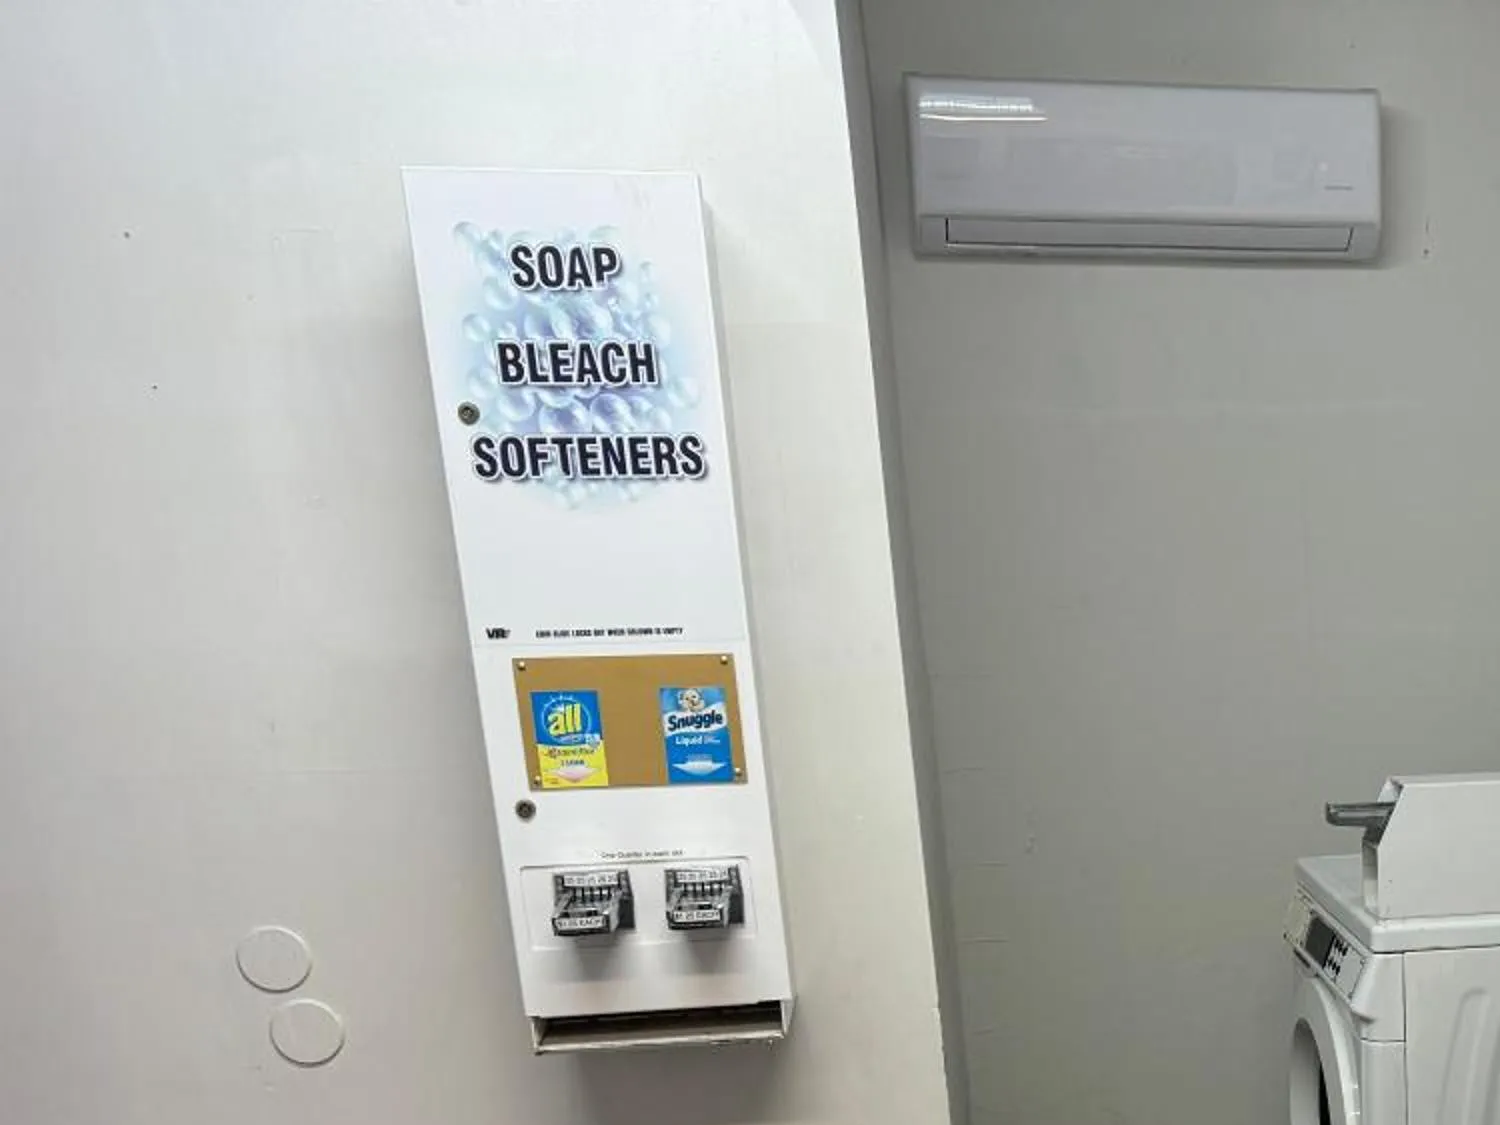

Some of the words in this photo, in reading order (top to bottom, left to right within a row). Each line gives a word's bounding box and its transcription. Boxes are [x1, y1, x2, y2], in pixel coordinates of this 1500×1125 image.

[509, 243, 619, 290] SOAP
[497, 342, 659, 385] BLEACH
[471, 435, 706, 478] SOFTENERS
[547, 703, 582, 737] all
[667, 709, 723, 732] Snuggle
[675, 735, 703, 748] Liquid
